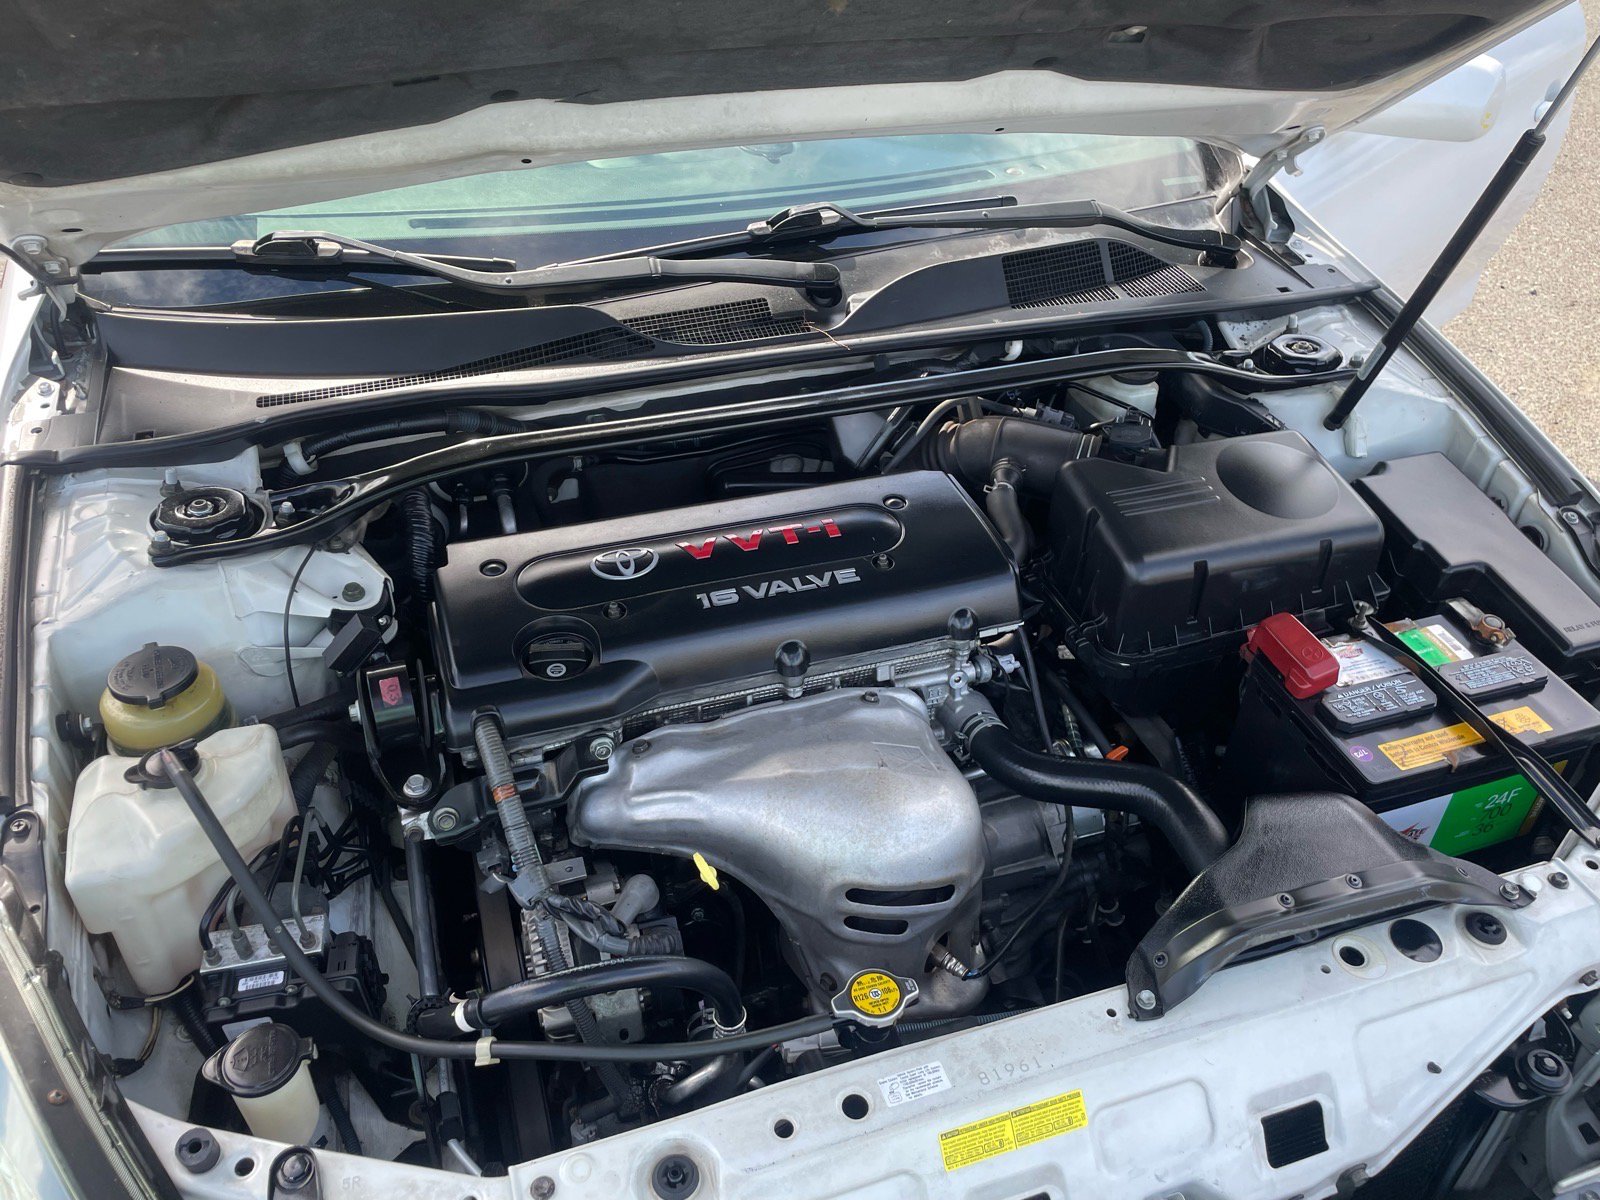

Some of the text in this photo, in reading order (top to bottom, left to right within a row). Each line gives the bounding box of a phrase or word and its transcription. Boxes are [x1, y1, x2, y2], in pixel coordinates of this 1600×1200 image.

[675, 518, 842, 560] VVT-i
[696, 567, 861, 610] 16 VALVE
[1342, 686, 1371, 698] DANGER
[1376, 678, 1403, 690] POISON
[1484, 787, 1522, 809] 24F
[1479, 802, 1513, 821] 700
[978, 1055, 1042, 1085] 81961
